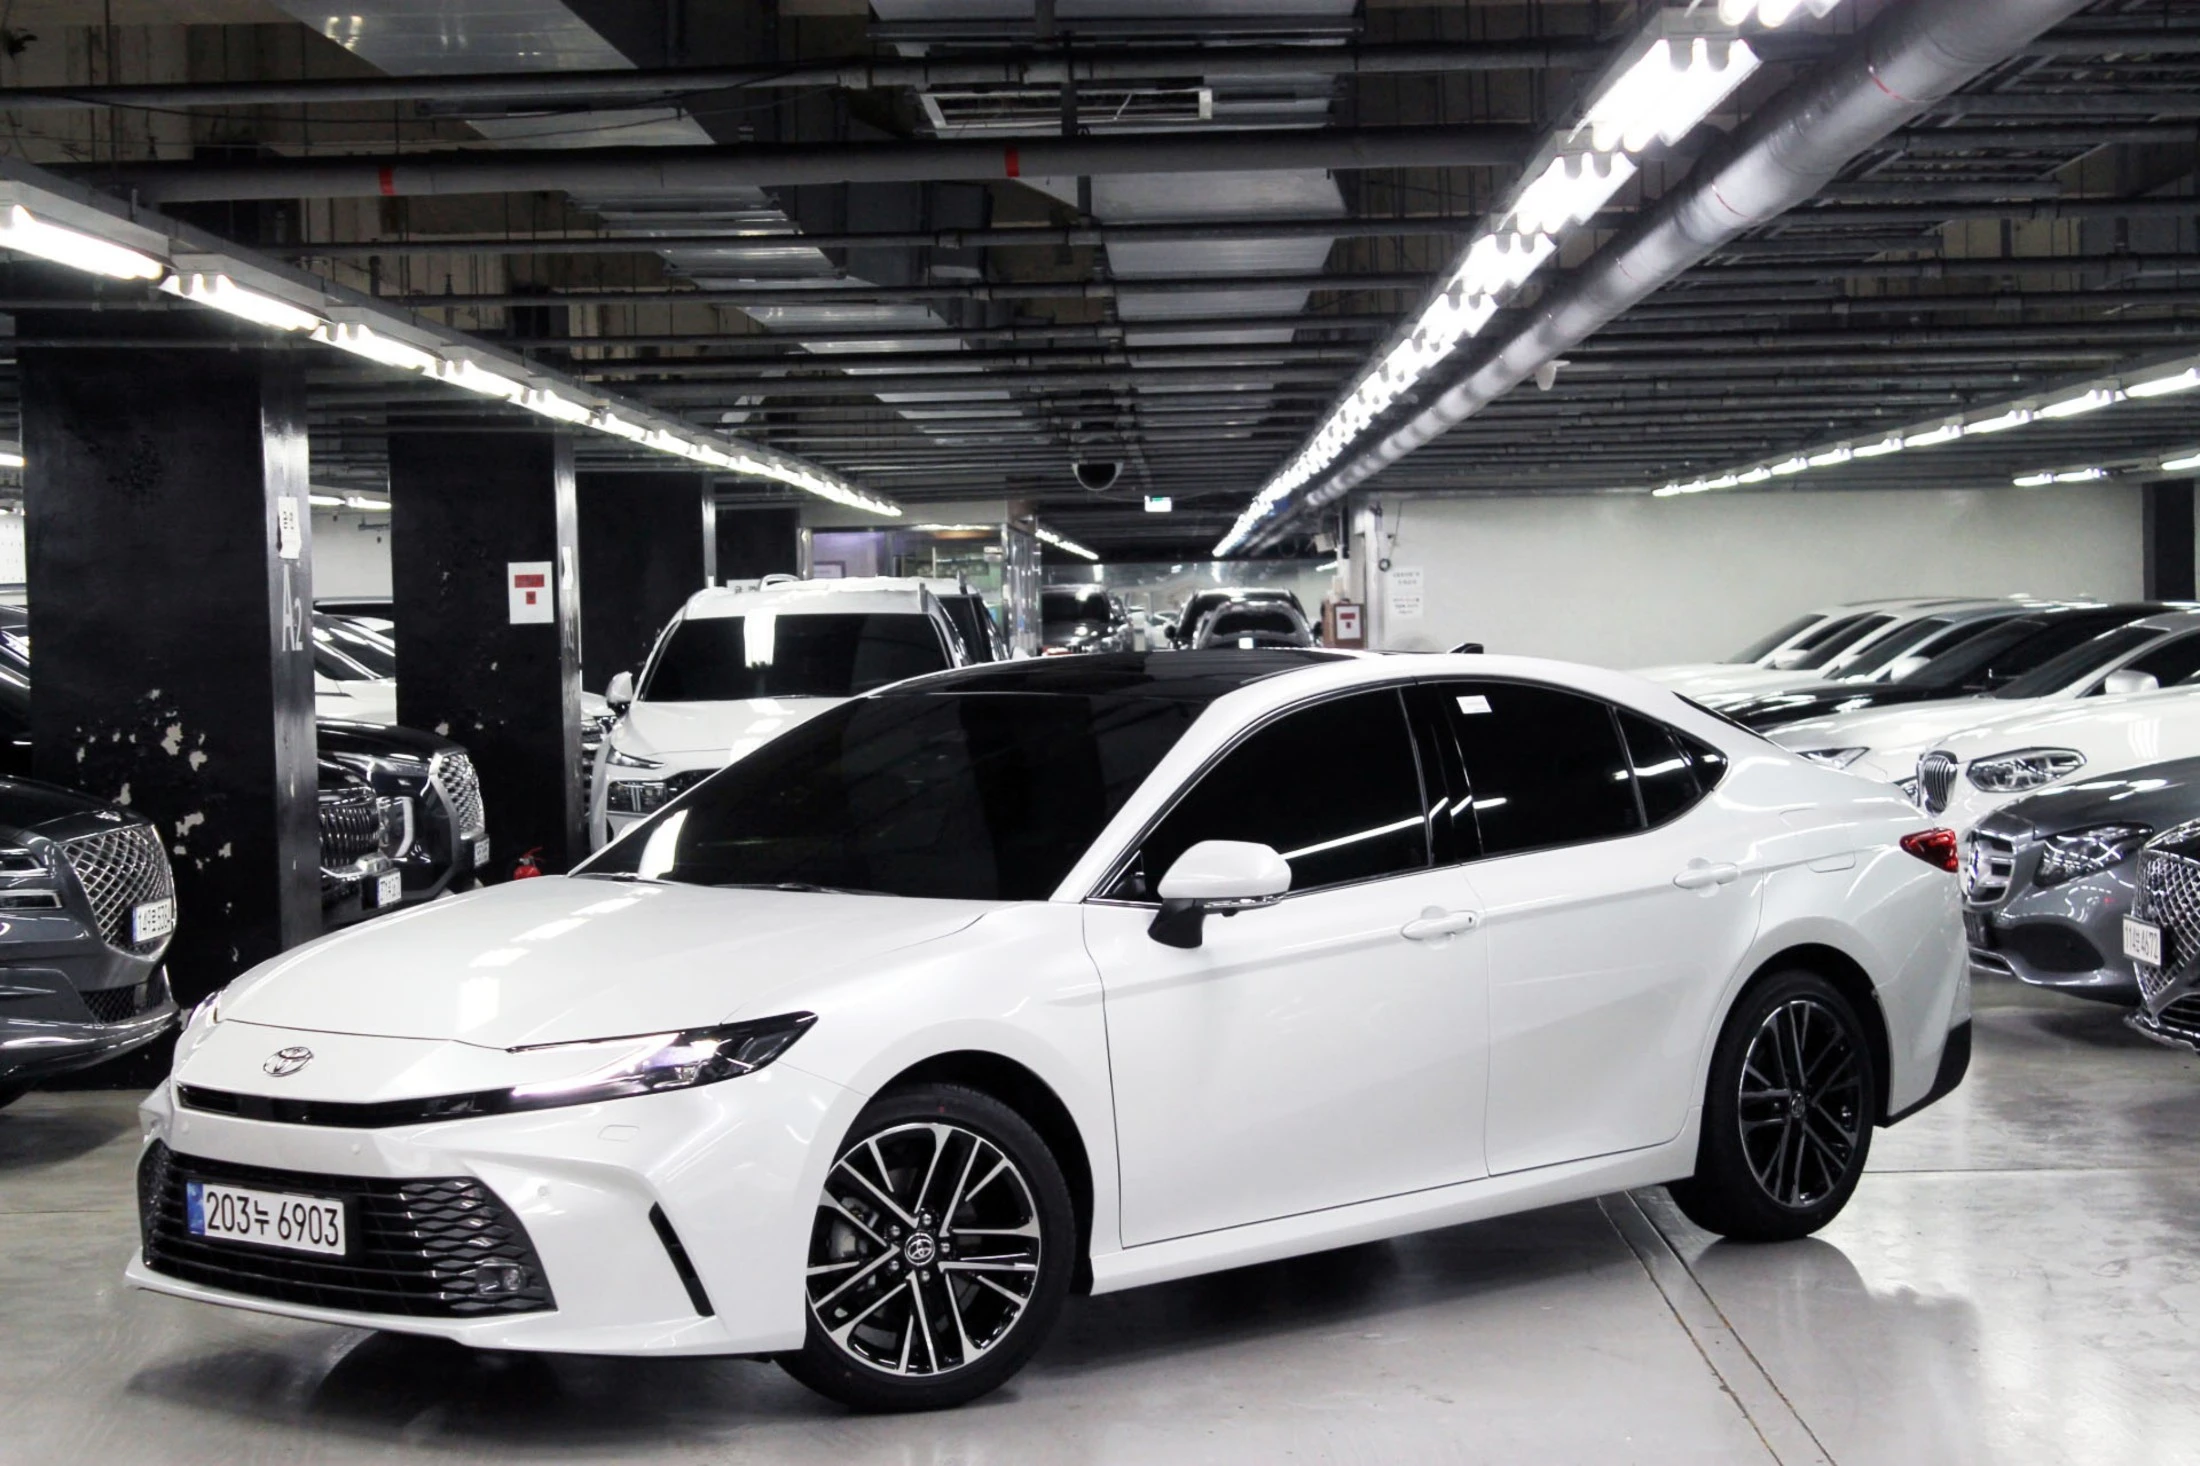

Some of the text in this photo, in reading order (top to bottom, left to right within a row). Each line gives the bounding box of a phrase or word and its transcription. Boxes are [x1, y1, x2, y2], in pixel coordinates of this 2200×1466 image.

[282, 563, 303, 652] A2
[206, 1191, 339, 1247] 203누 6903
